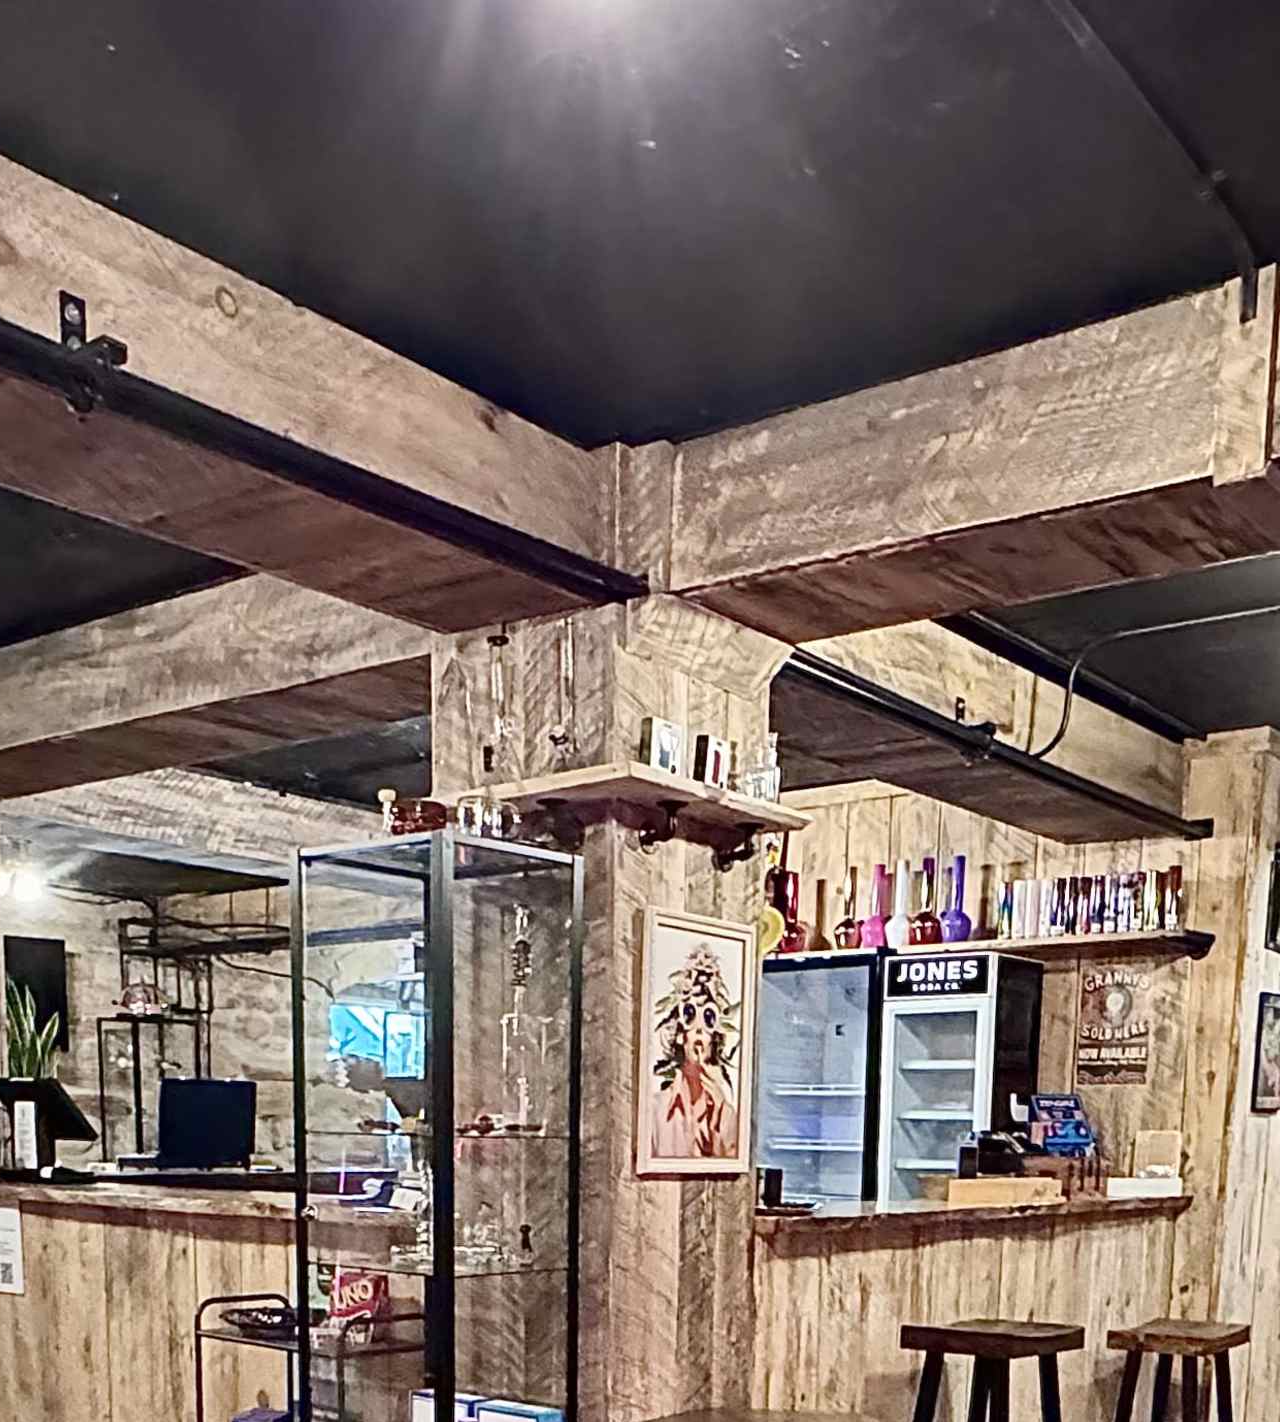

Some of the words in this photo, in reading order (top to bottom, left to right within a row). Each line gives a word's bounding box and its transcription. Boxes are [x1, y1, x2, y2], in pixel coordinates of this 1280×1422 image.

[896, 960, 978, 983] JONES
[1081, 1024, 1113, 1041] SOLD
[1114, 1021, 1148, 1040] HERE
[331, 1279, 374, 1312] UNO
